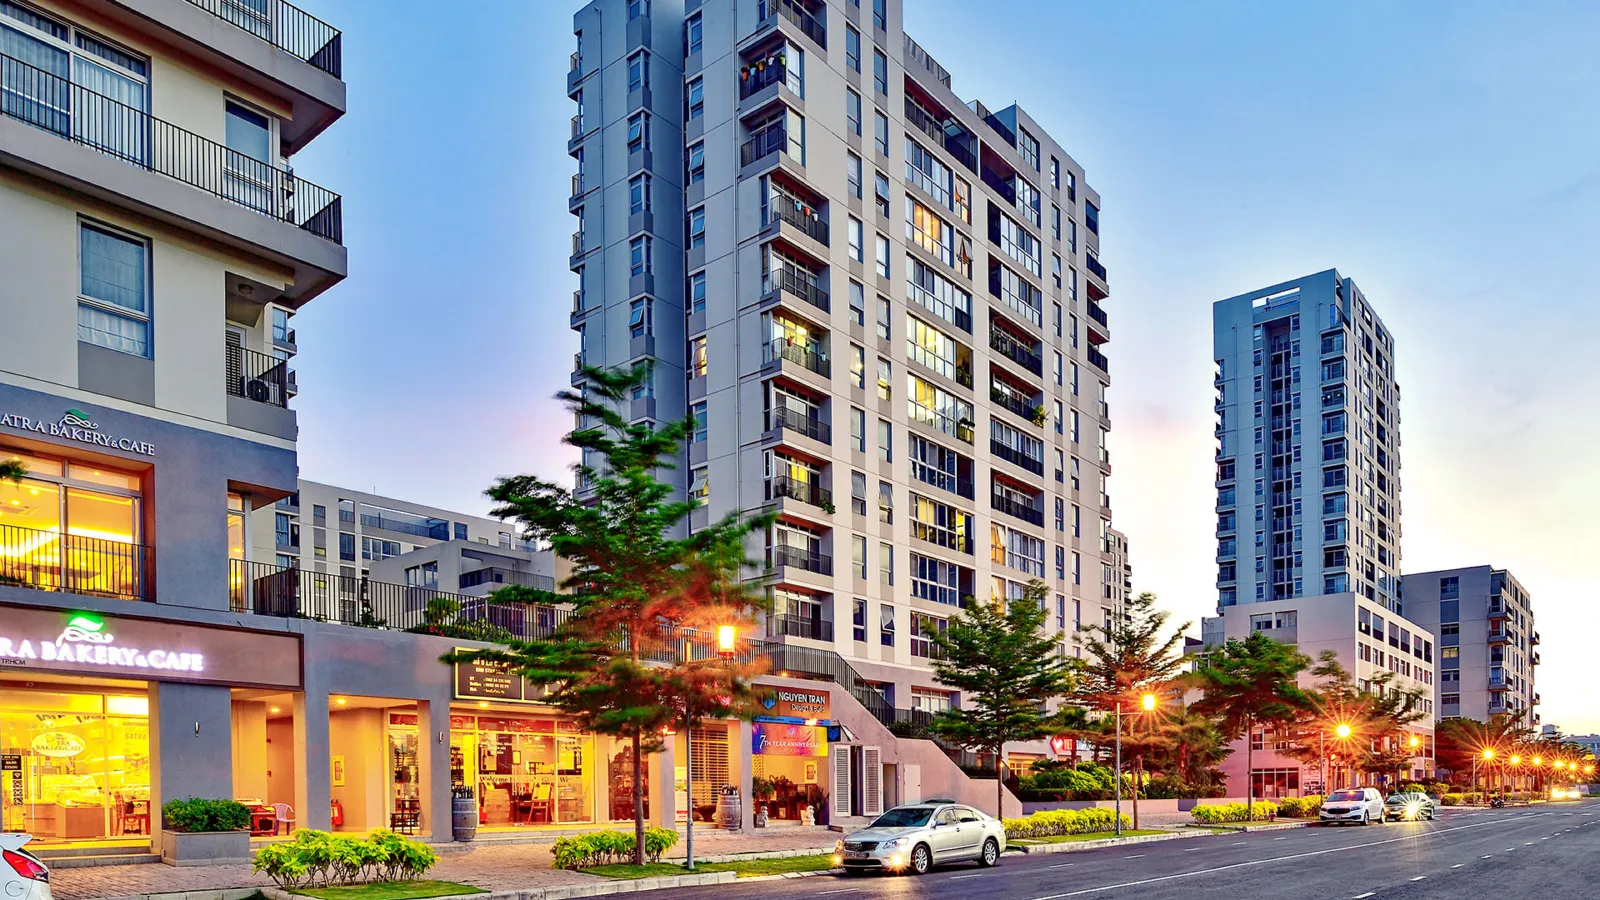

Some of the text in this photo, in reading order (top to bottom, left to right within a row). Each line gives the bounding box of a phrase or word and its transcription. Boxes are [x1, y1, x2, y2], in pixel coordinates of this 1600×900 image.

[0, 413, 46, 434] ATRA
[778, 692, 826, 705] NGUYEN TRAN
